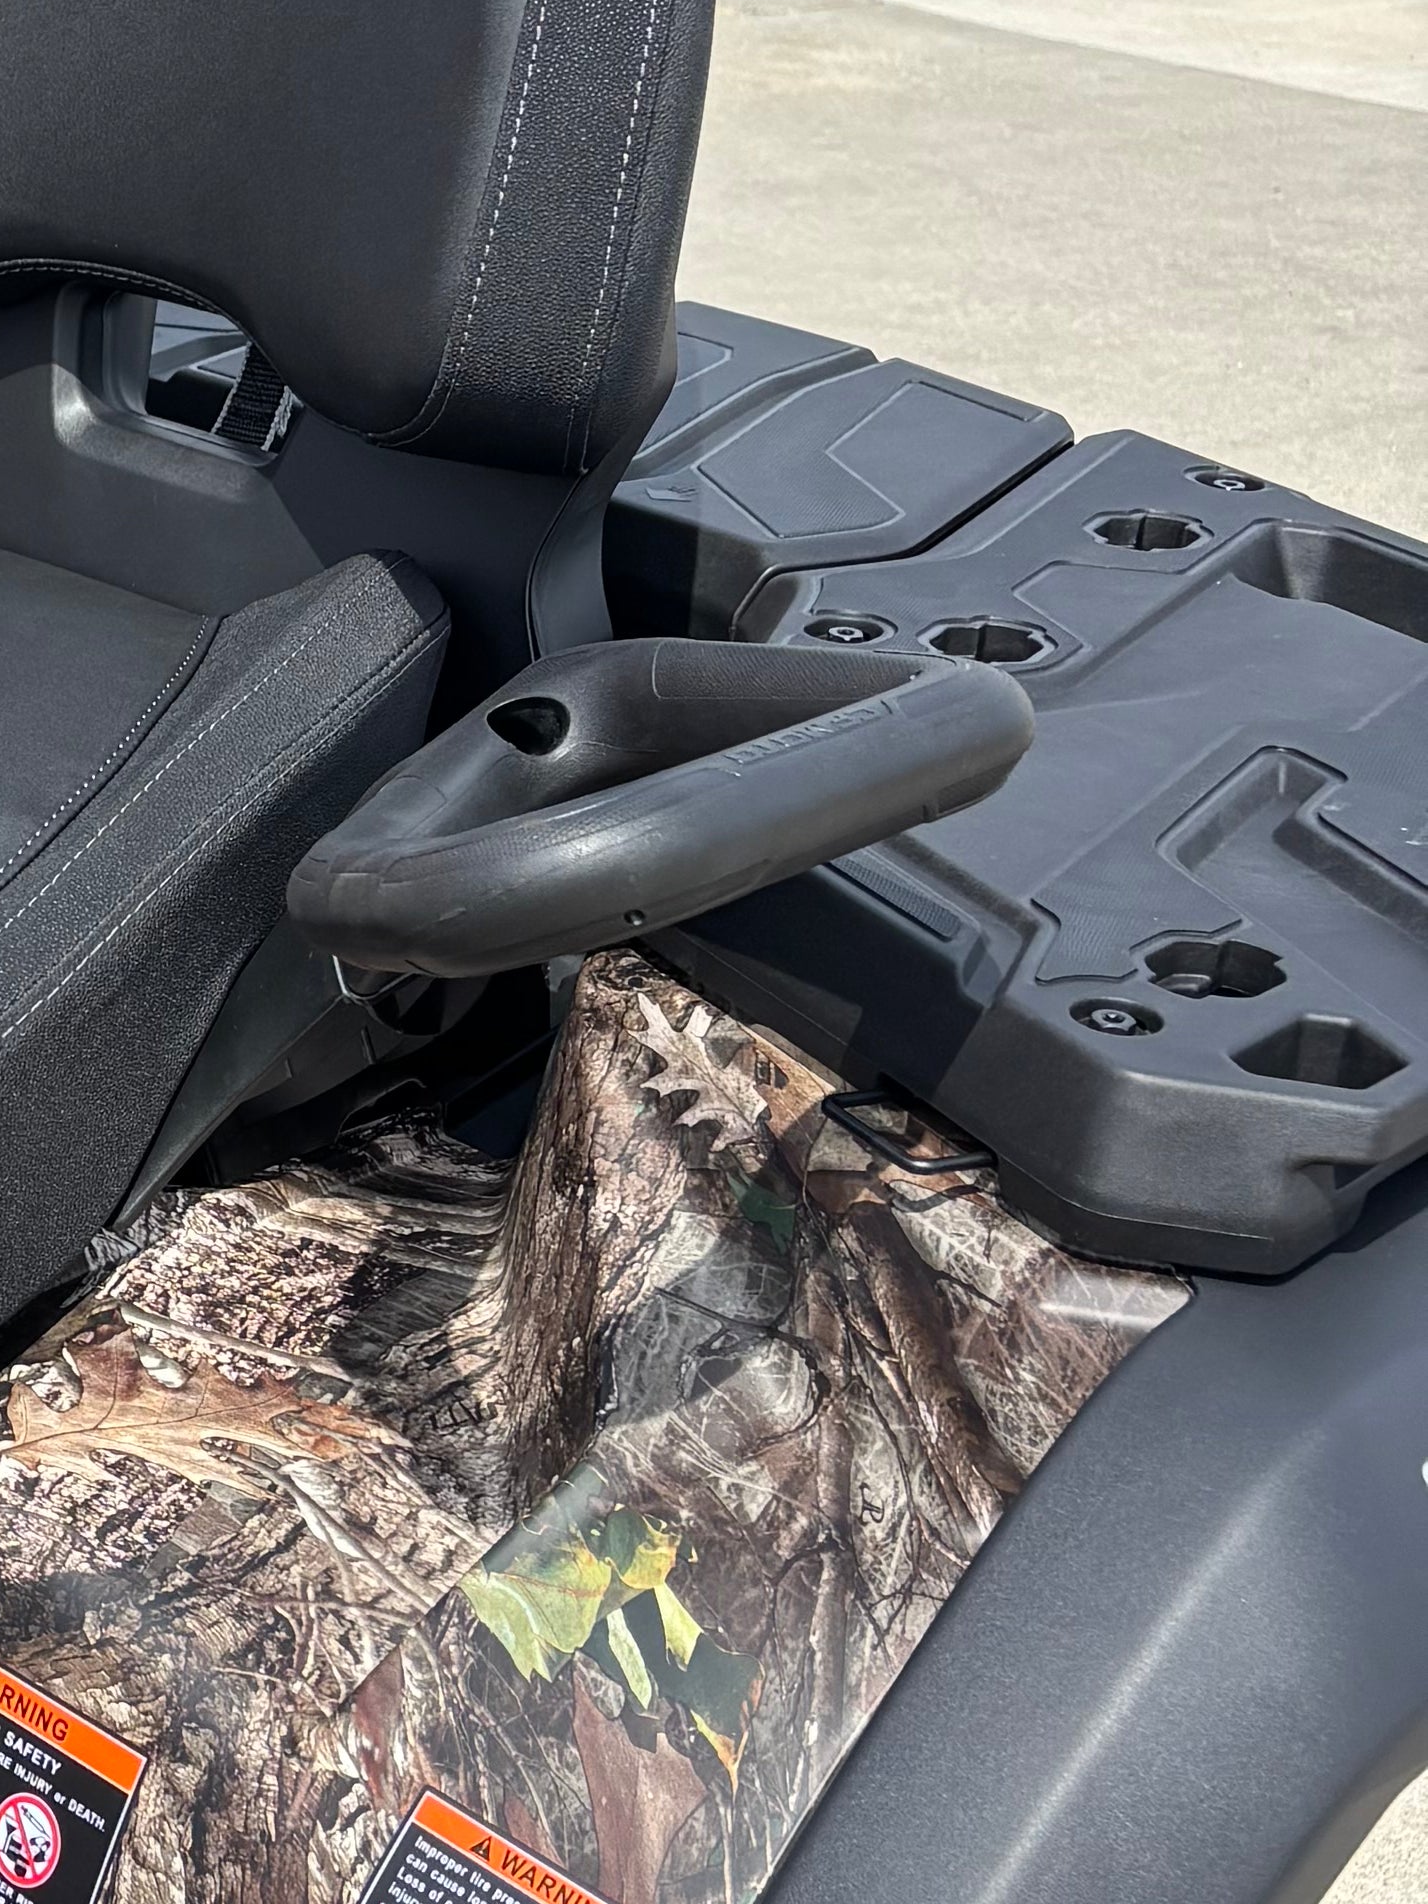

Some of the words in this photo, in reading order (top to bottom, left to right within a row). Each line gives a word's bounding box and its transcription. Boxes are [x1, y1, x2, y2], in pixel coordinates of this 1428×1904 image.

[4, 1731, 61, 1774] SAFETY
[13, 1763, 52, 1794] INJURY
[53, 1791, 66, 1804] or
[67, 1798, 104, 1831] DEATH.
[396, 1866, 426, 1892] Loss
[428, 1889, 444, 1902] of
[405, 1853, 428, 1872] can
[430, 1869, 465, 1896] cause
[414, 1835, 467, 1876] Improper
[469, 1870, 491, 1892] tire
